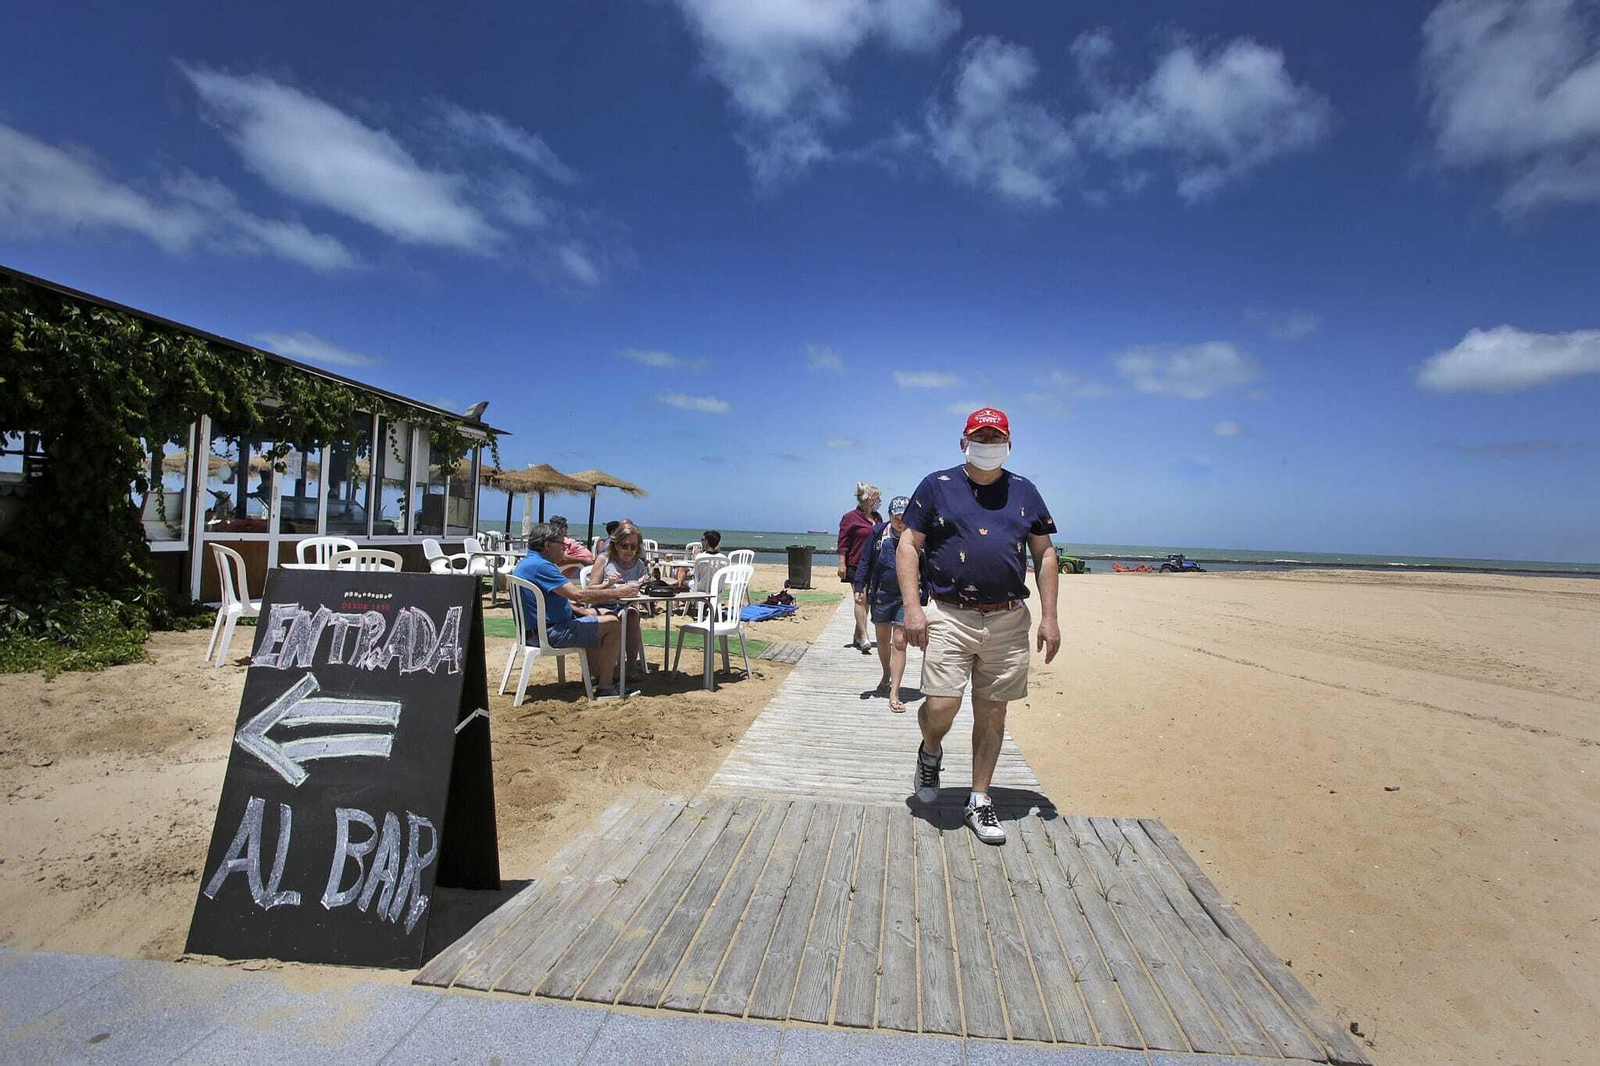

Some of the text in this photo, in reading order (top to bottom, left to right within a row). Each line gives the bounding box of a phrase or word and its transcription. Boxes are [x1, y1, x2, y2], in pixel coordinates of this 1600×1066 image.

[249, 602, 464, 675] ENTRADA
[341, 602, 367, 610] DESDE
[204, 795, 438, 935] AL BAR
